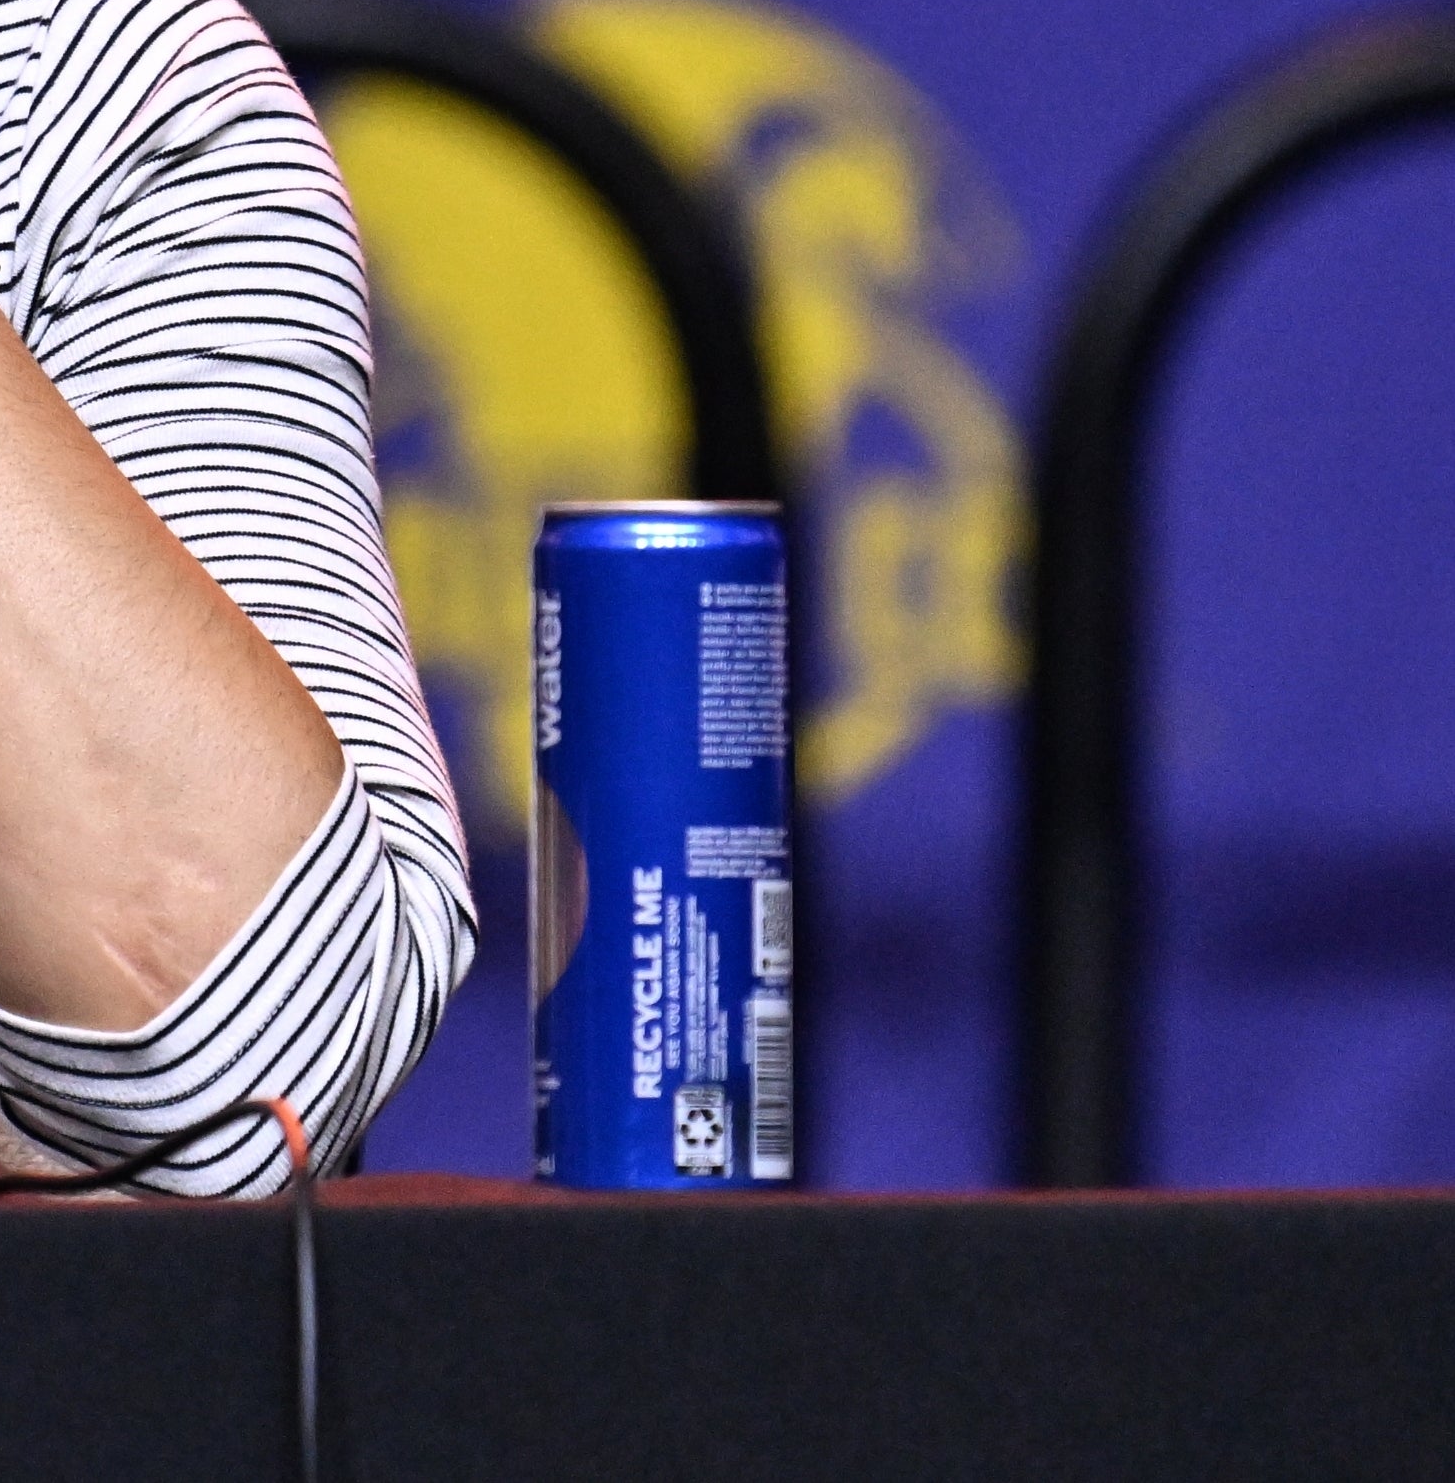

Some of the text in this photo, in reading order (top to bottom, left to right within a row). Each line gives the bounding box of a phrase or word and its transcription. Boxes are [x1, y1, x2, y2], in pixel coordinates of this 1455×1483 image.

[633, 866, 663, 1098] RECYCLE ME
[665, 948, 681, 1000] AGAIN
[665, 1002, 681, 1037] YOU
[665, 1038, 681, 1070] SEE
